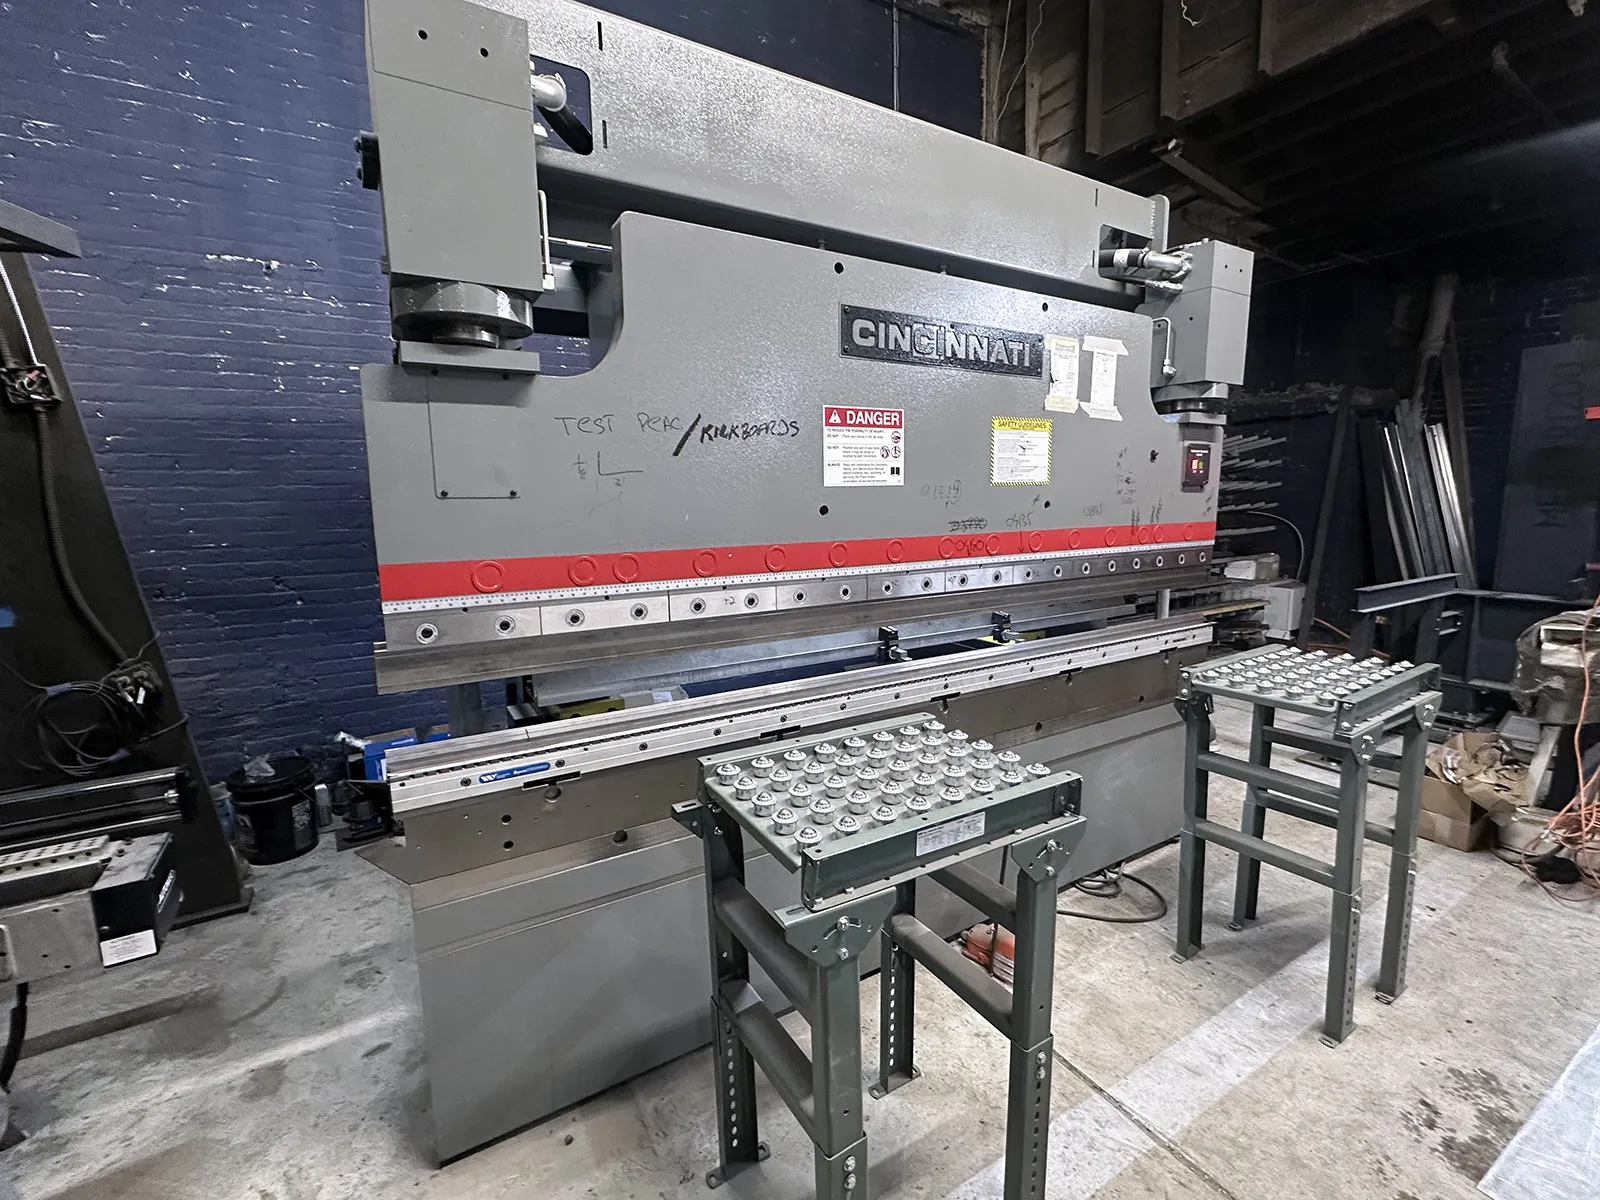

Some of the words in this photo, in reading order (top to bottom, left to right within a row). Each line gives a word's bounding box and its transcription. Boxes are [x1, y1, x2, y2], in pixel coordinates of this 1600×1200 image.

[851, 318, 1031, 367] CINCINNATI
[846, 410, 900, 426] DANGER
[998, 420, 1017, 428] SAFETY
